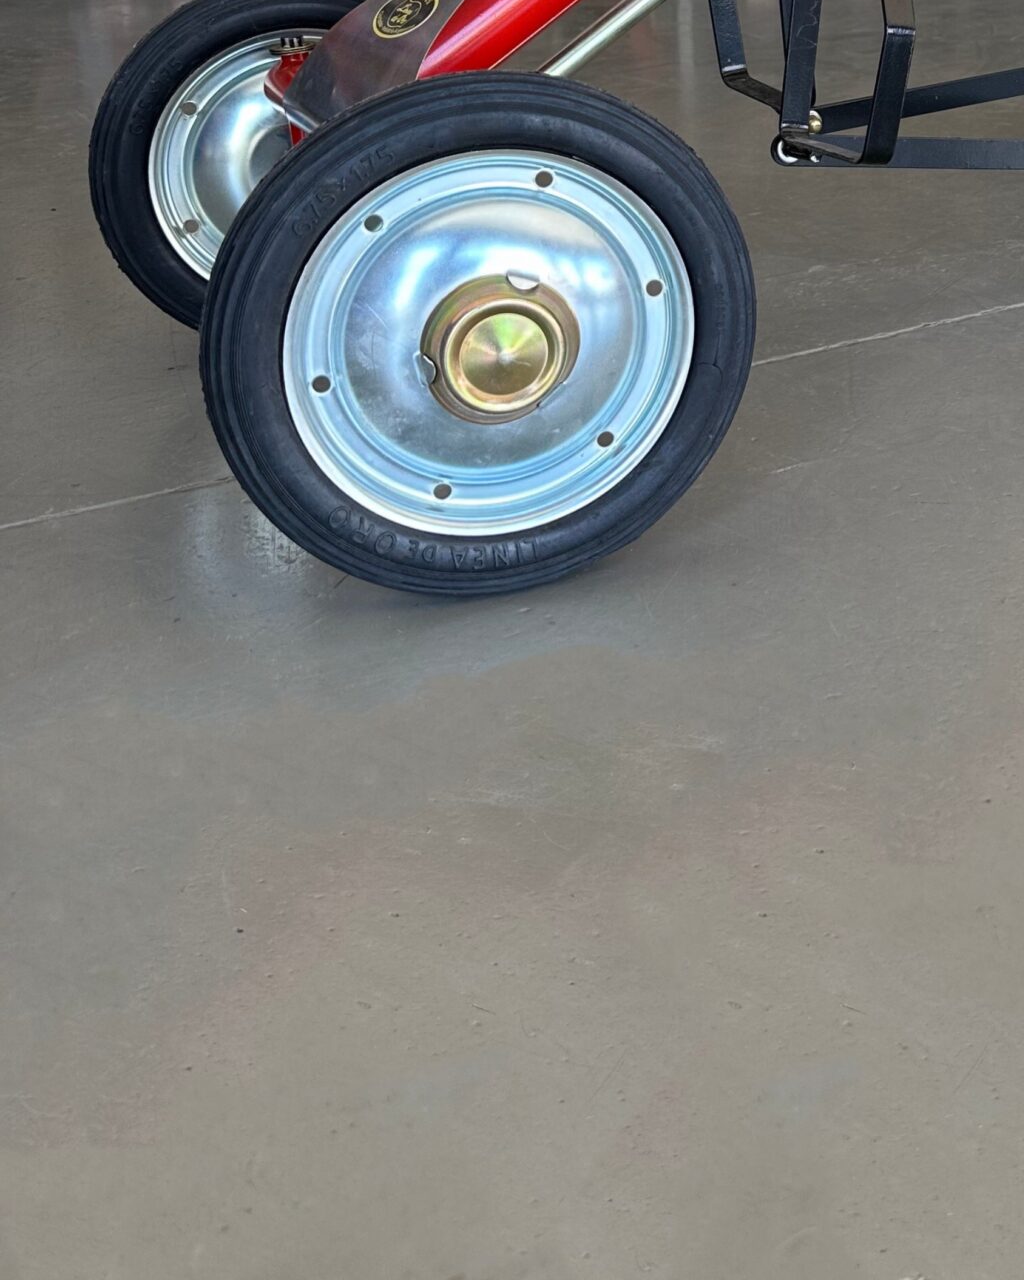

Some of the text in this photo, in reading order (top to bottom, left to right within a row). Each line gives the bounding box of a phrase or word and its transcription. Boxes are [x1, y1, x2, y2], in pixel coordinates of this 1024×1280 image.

[328, 506, 539, 570] LINEA DE ORO
